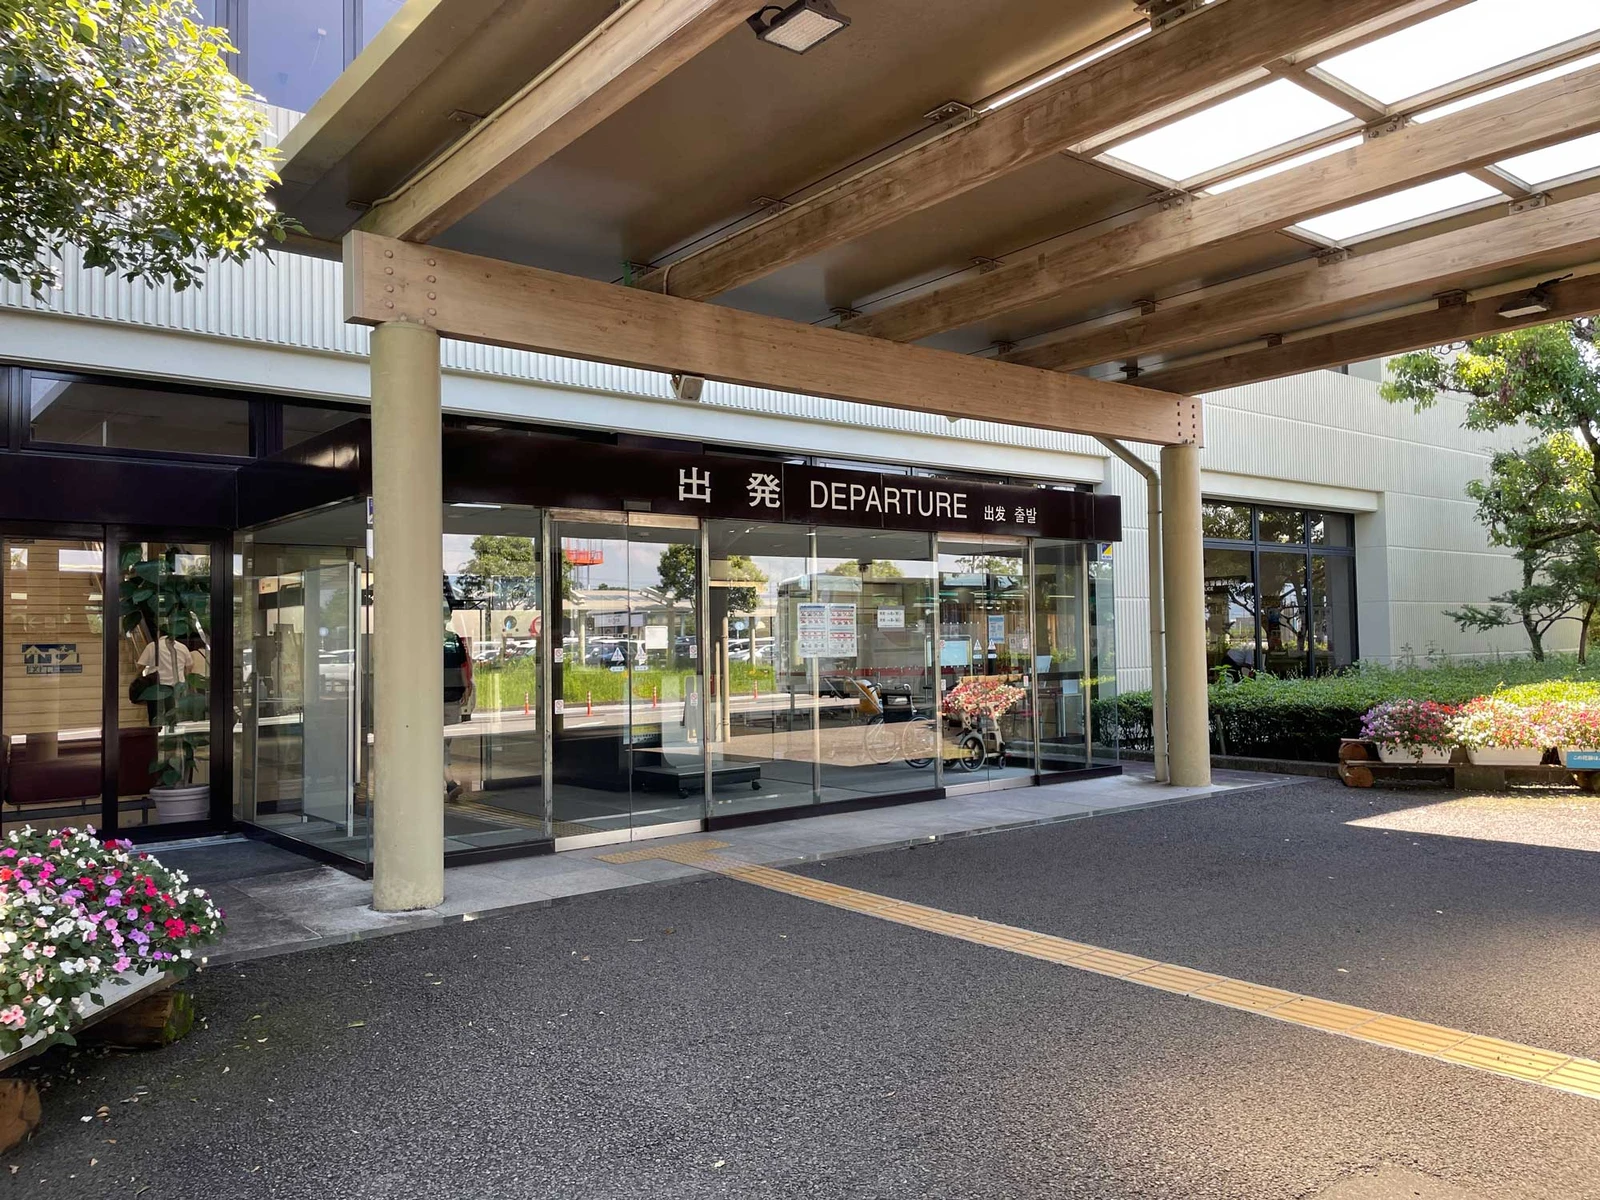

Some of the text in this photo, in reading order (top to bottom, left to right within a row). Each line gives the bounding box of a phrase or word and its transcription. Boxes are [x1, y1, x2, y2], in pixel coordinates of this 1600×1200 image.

[678, 466, 781, 508] 出発
[810, 480, 968, 519] DEPARTURE
[983, 504, 1007, 522] 出发
[1014, 506, 1038, 524] 출발
